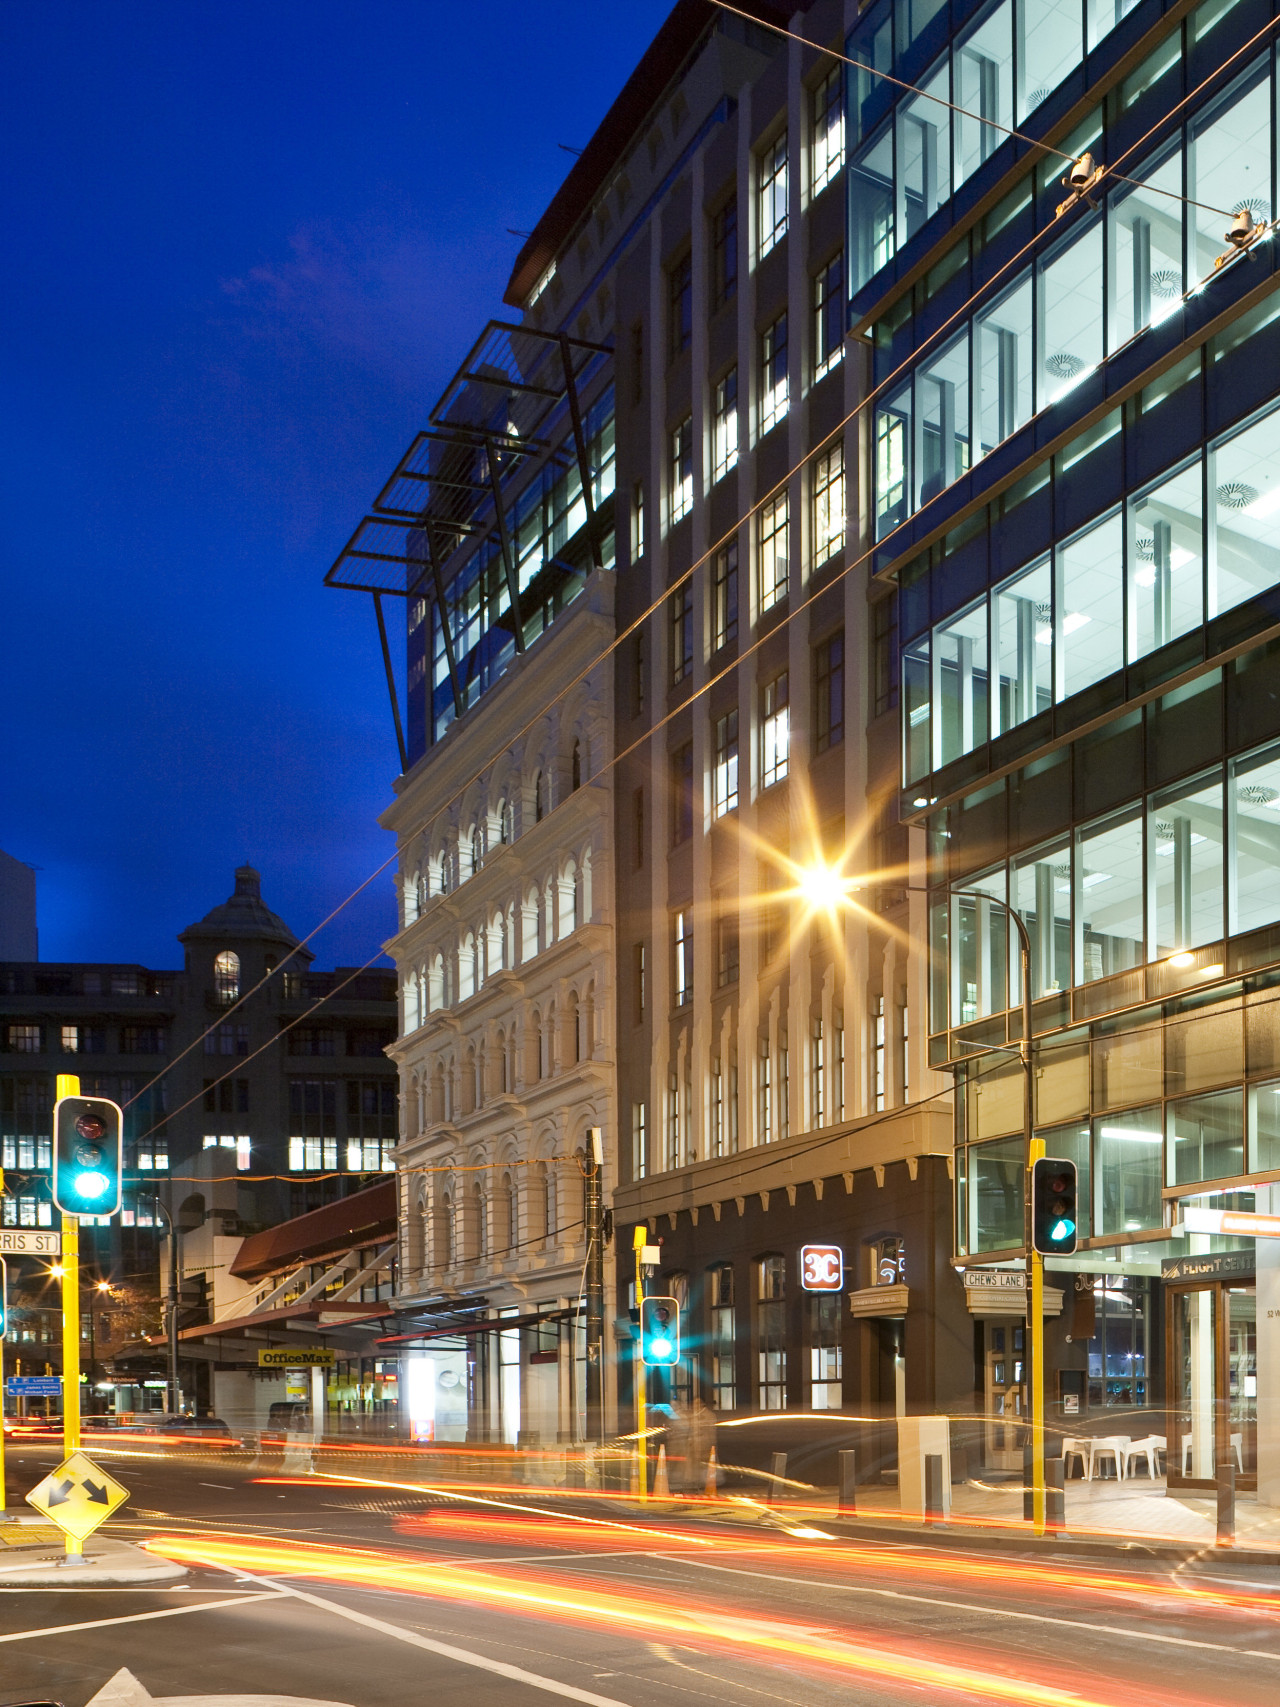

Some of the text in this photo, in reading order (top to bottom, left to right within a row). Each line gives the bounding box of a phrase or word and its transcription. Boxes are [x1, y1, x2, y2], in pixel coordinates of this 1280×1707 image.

[0, 1235, 52, 1250] RIS ST
[805, 1253, 839, 1283] 3C
[1183, 1259, 1222, 1275] FLIGHT
[970, 1274, 1021, 1286] CHEWS LANE
[1267, 1310, 1274, 1318] 52
[263, 1353, 332, 1364] OfficeMax
